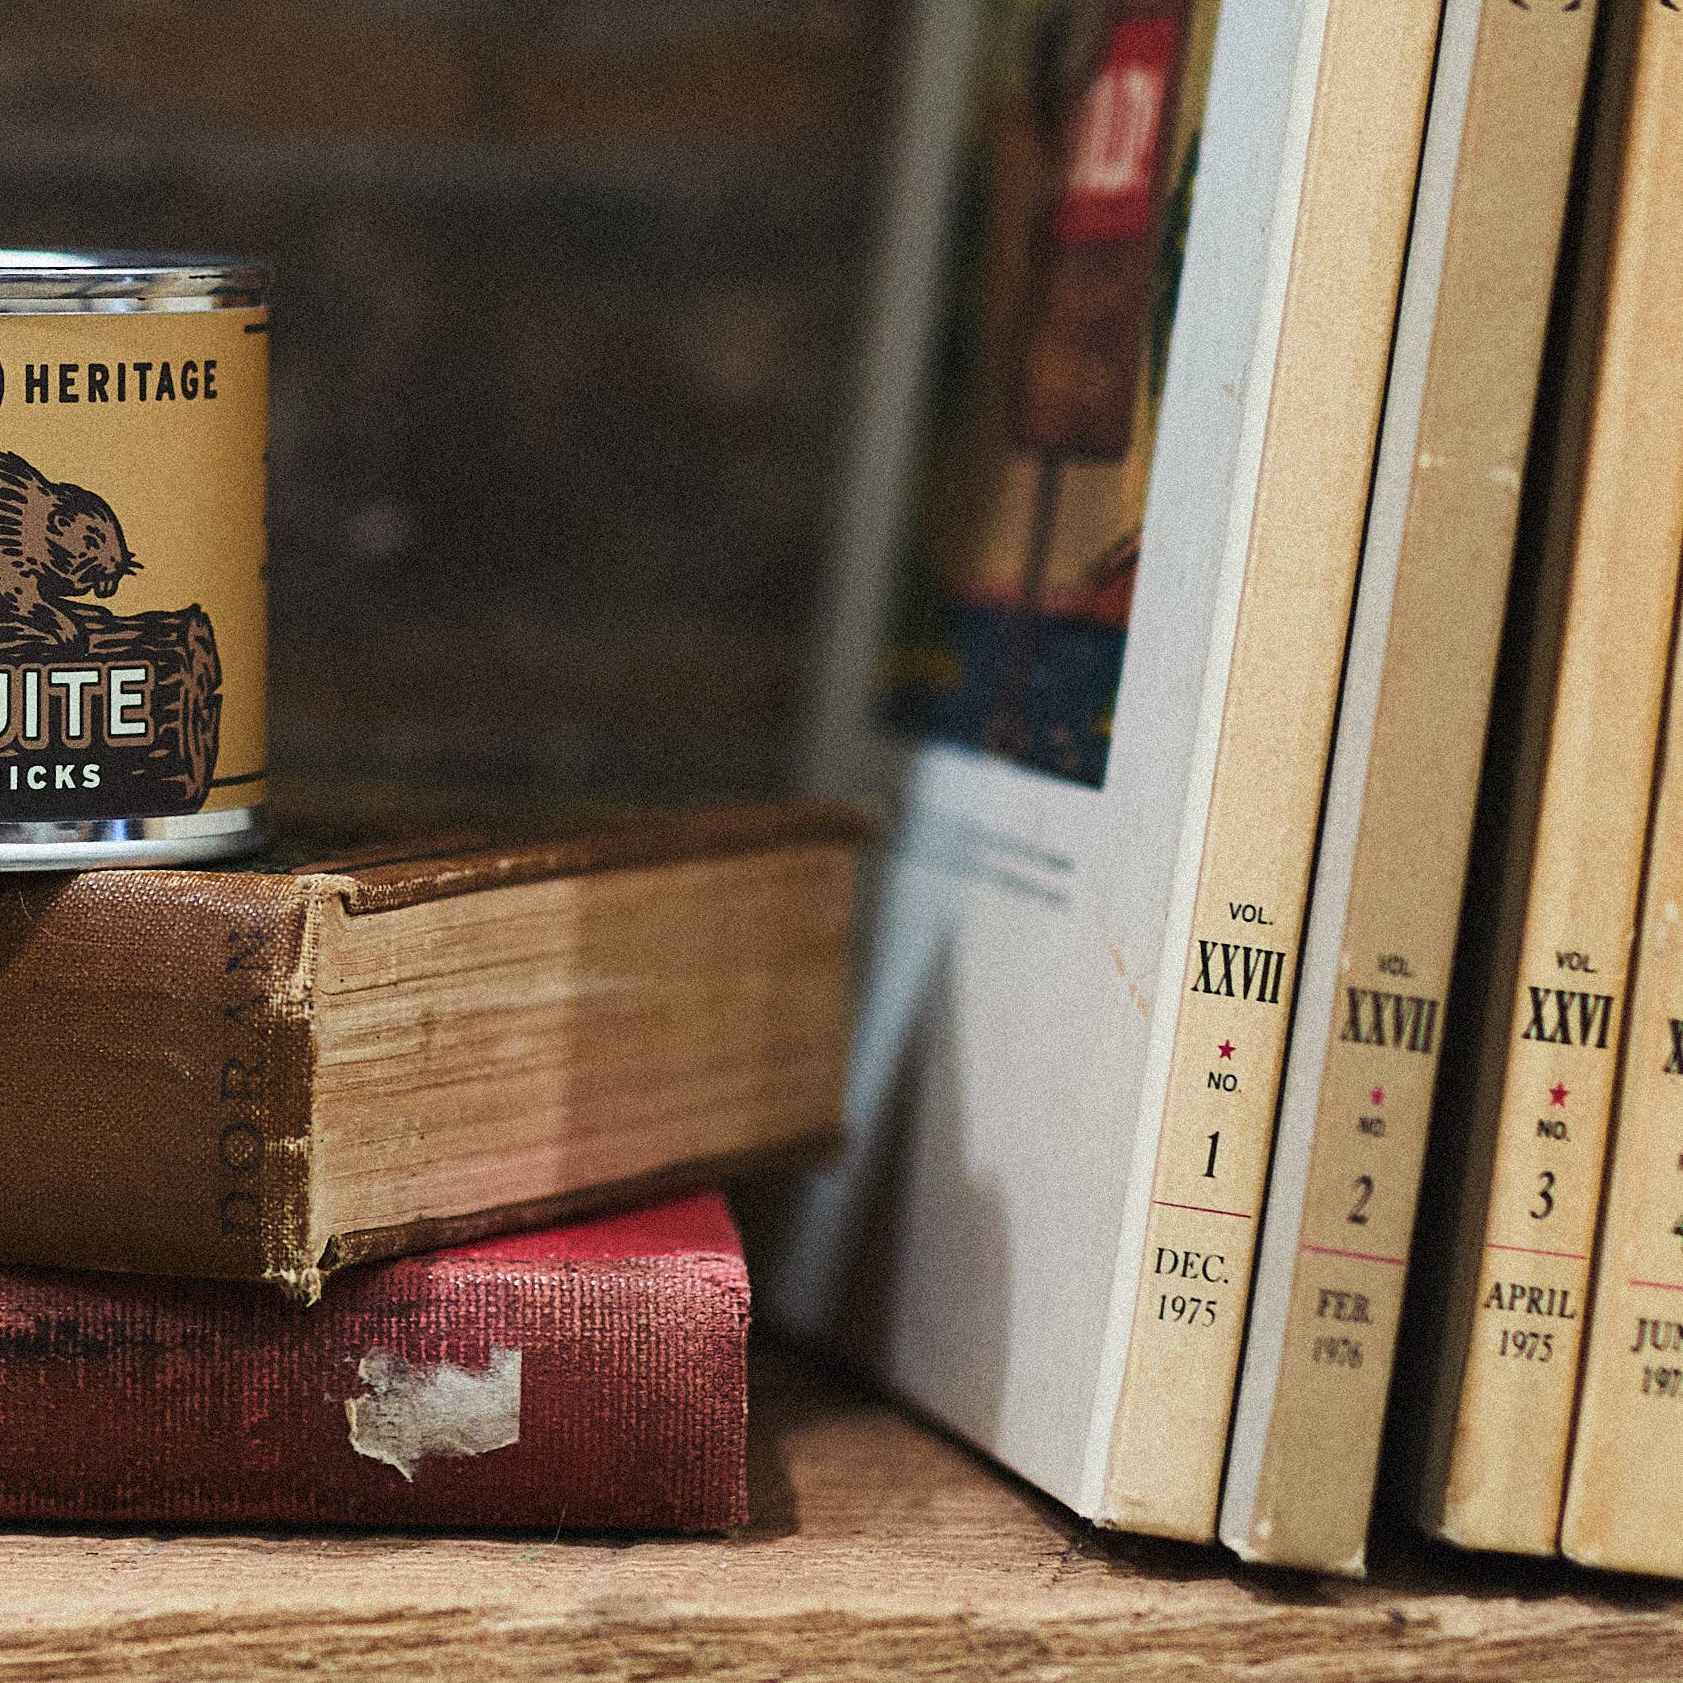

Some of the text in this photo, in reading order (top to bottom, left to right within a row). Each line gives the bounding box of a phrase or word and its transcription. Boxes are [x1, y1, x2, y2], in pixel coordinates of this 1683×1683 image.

[24, 359, 218, 404] HERITAGE
[1228, 902, 1274, 926] VOL.
[1190, 939, 1287, 1005] XXVII
[1340, 986, 1440, 1055] XXVII
[1521, 985, 1614, 1050] XXVI
[1207, 1071, 1243, 1094] NO.
[1201, 1130, 1220, 1179] 1
[1346, 1174, 1375, 1225] 2
[1529, 1170, 1556, 1220] 3
[1154, 1247, 1230, 1285] DEC.
[1159, 1294, 1218, 1328] 1975
[1483, 1281, 1579, 1320] APRIL
[1499, 1328, 1554, 1363] 1975
